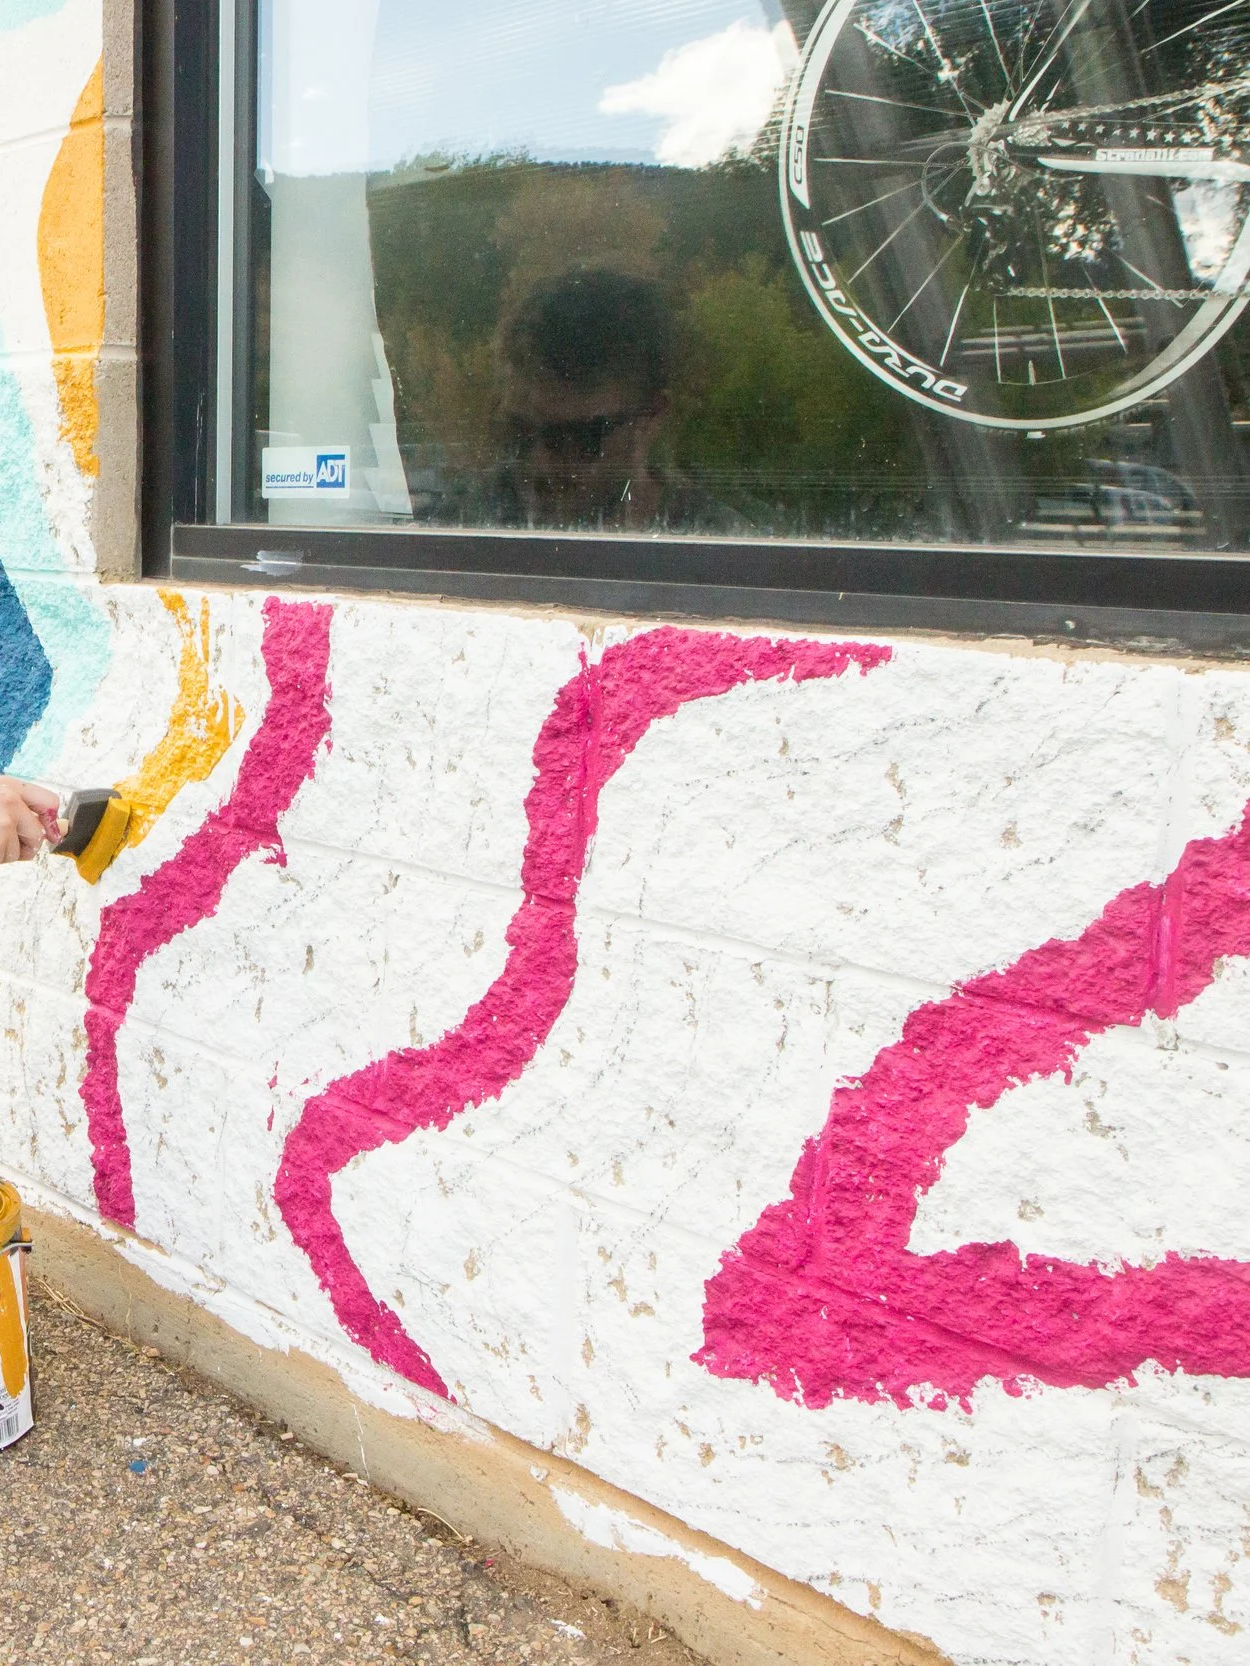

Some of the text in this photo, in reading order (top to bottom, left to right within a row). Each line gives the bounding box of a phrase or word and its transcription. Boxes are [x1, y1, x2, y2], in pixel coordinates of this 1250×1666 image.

[800, 231, 968, 402] DURA-ACE
[265, 460, 346, 484] secured by ADT
